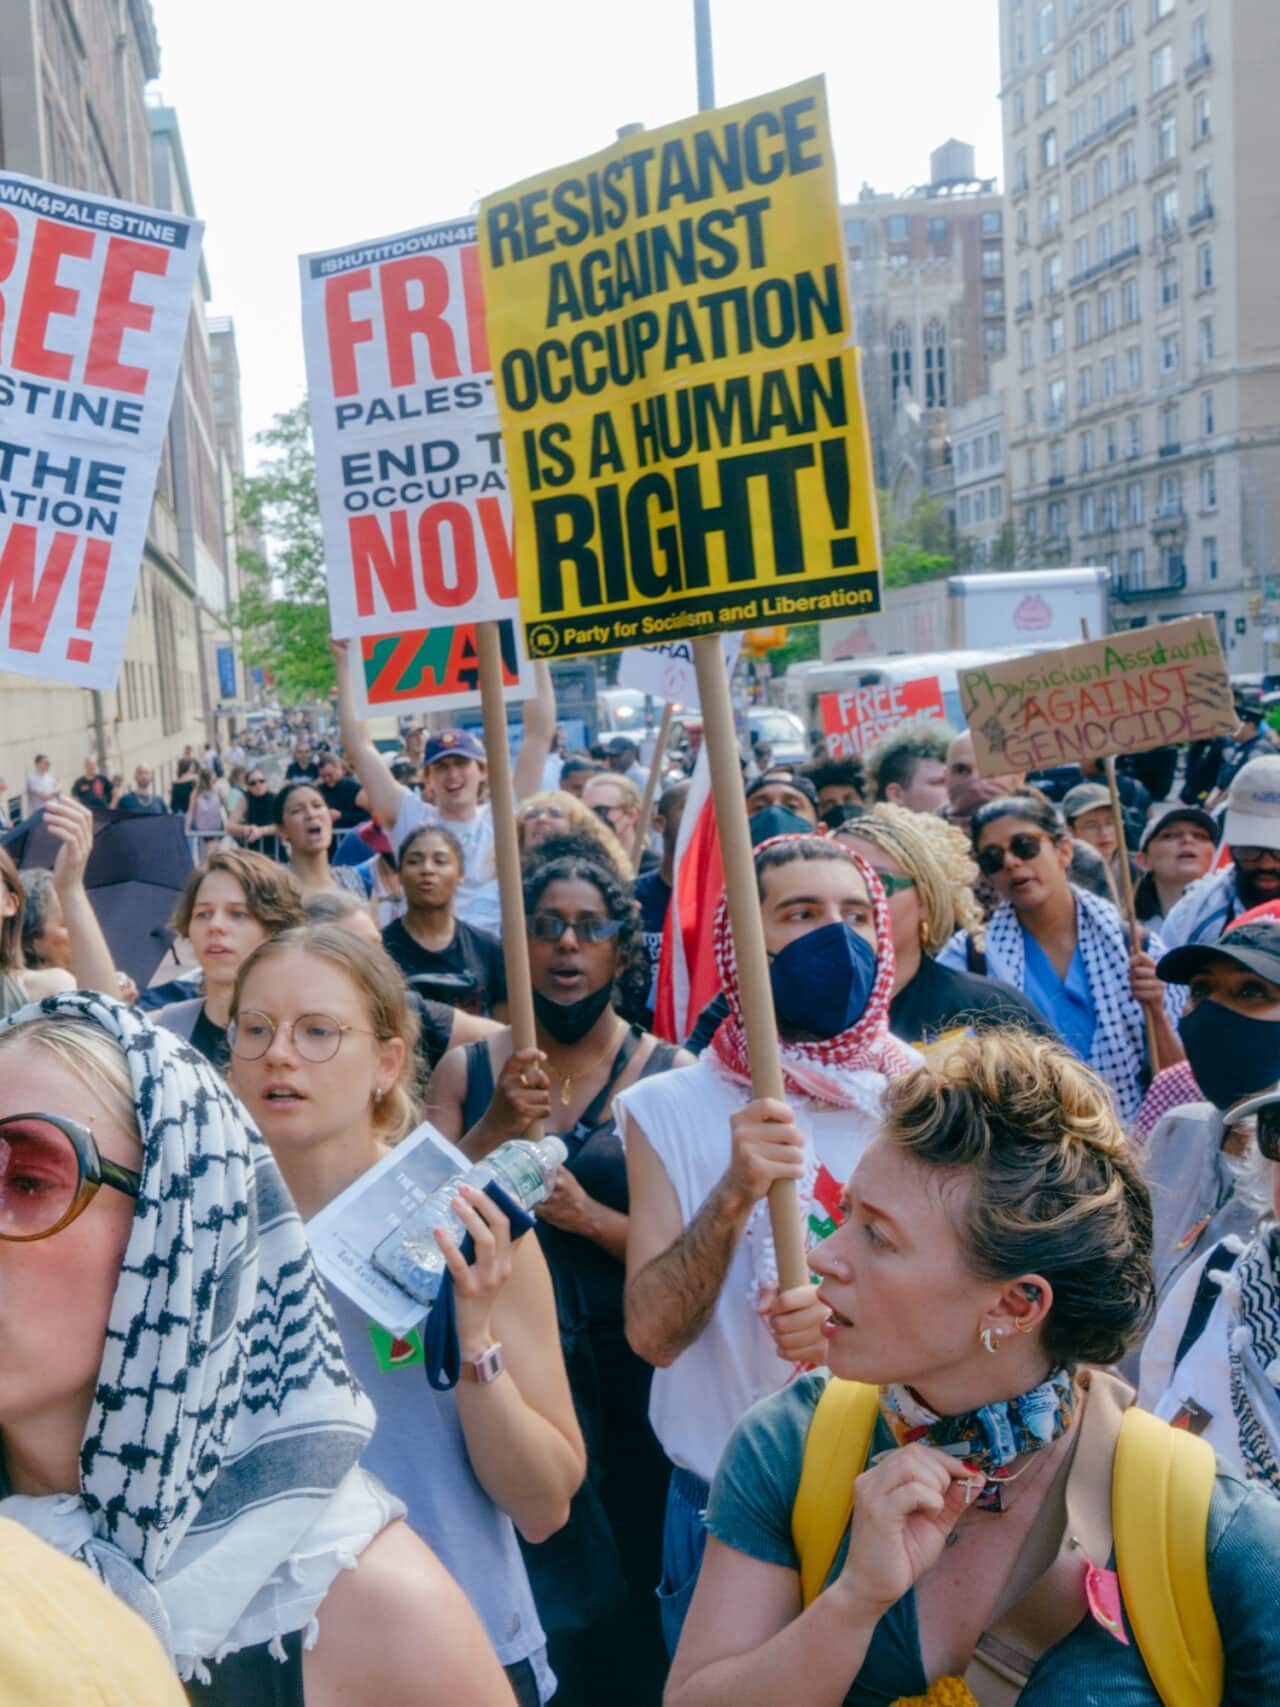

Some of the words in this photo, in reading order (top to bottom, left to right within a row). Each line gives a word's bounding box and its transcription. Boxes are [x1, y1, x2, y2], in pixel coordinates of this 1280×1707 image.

[487, 96, 824, 267] RESISTANCE
[546, 198, 771, 330] AGAINST
[501, 263, 844, 413] OCCUPATION
[524, 424, 575, 492] IS
[589, 411, 624, 480] A
[638, 356, 849, 470] HUMAN
[341, 439, 461, 487] END
[343, 468, 508, 512] OCCUPA
[533, 438, 861, 615] RIGHT!
[563, 626, 610, 645] Party
[614, 622, 638, 638] for
[718, 599, 758, 622] and
[761, 588, 874, 616] Liberation
[837, 685, 908, 726] FREE
[963, 659, 1102, 707] Physician
[1022, 664, 1192, 731] AGAINST
